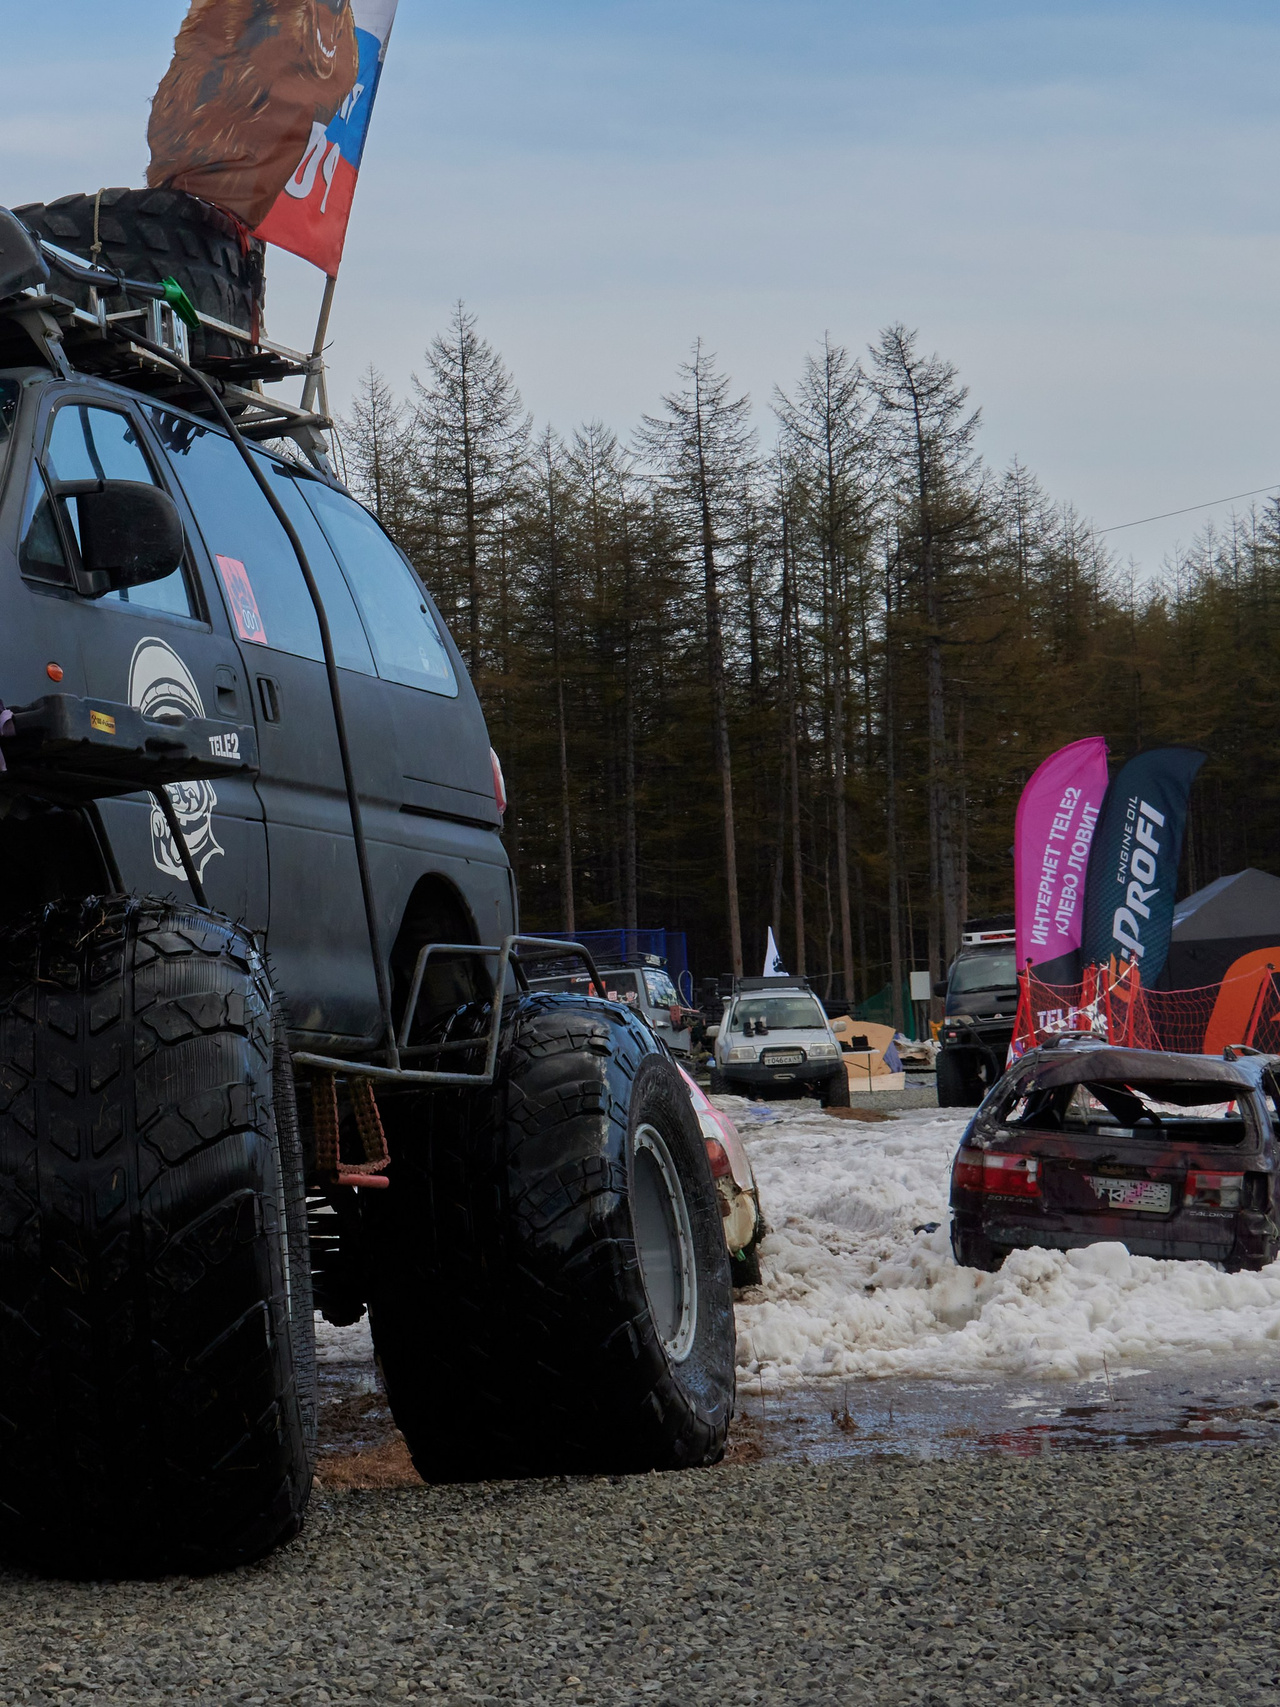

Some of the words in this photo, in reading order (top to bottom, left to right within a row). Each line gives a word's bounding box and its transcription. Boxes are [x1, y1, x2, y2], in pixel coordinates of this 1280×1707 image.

[242, 608, 260, 632] 001
[208, 732, 241, 760] TELE2
[1030, 844, 1062, 946] ИНТЕРНЕТ
[1049, 786, 1082, 842] TELE2
[1056, 870, 1080, 937] КЛЕВО
[1071, 801, 1101, 873] ЛОВИТ
[1117, 823, 1134, 885] ENGINE
[1126, 795, 1139, 821] OIL
